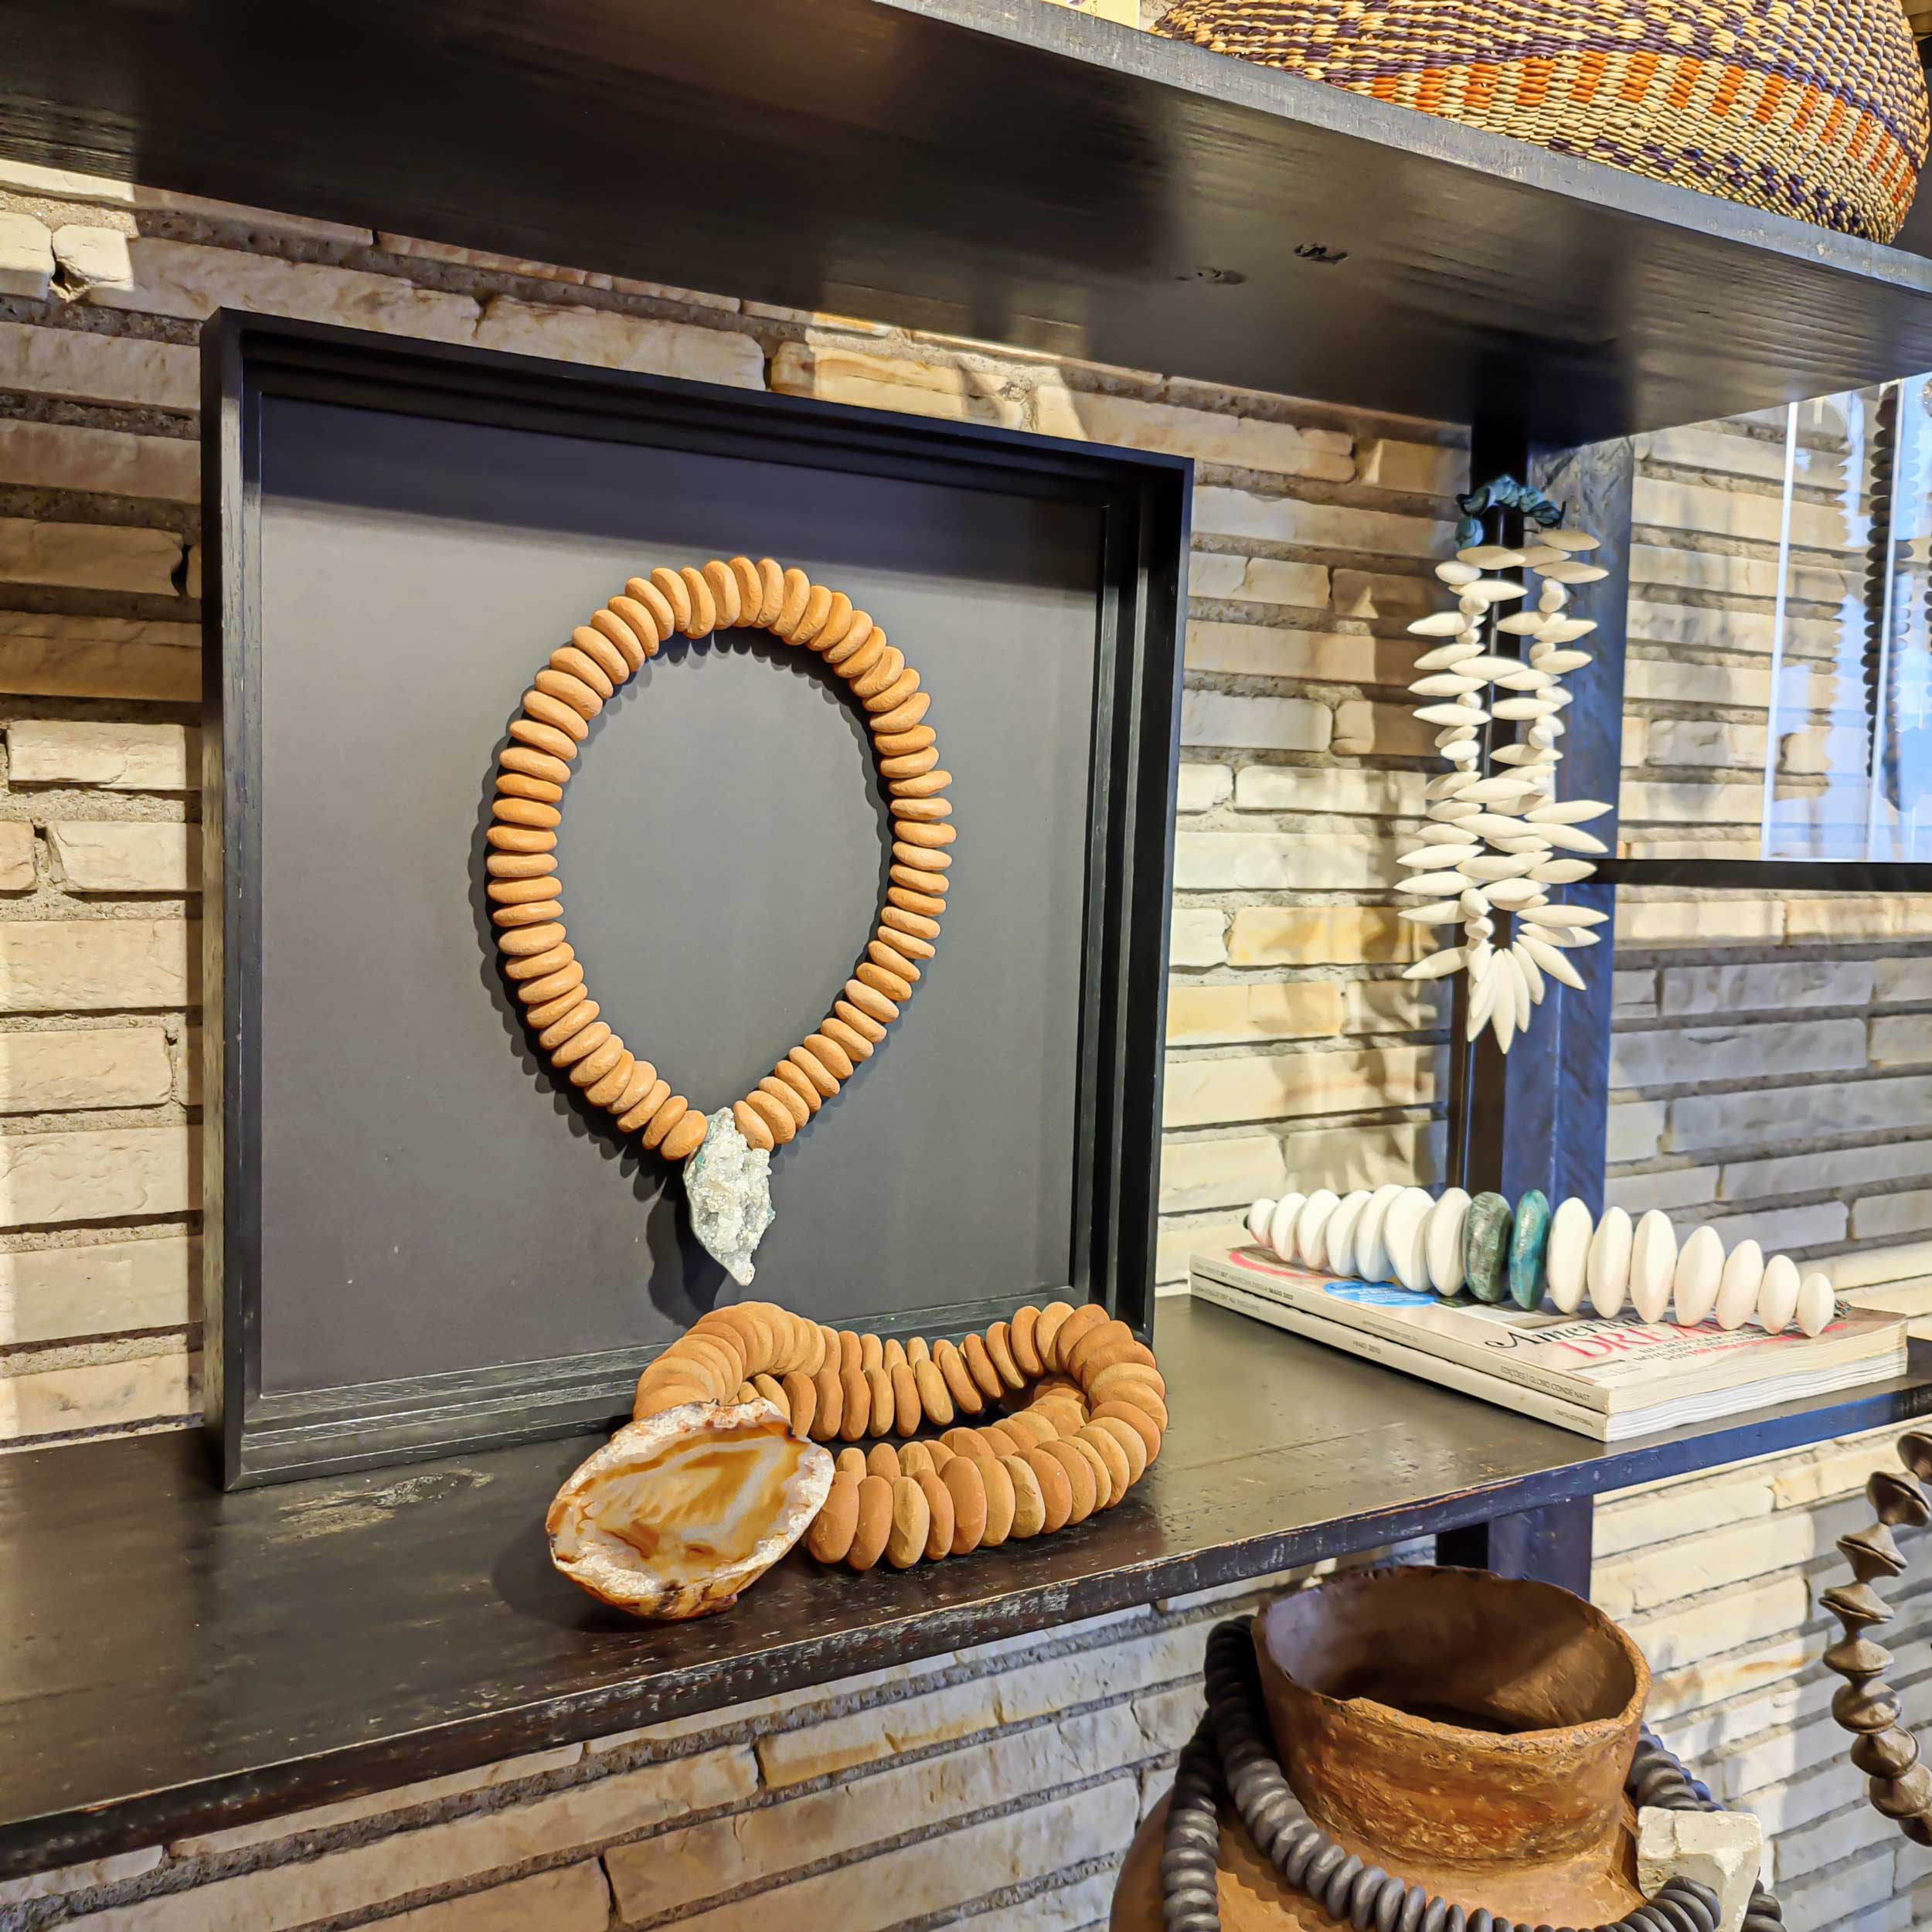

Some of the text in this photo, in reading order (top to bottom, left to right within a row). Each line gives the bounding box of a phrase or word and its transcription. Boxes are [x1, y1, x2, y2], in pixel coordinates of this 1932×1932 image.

[1484, 1315, 1668, 1349] America
[1528, 1375, 1550, 1388] GLOBO
[1573, 1391, 1590, 1402] NAST
